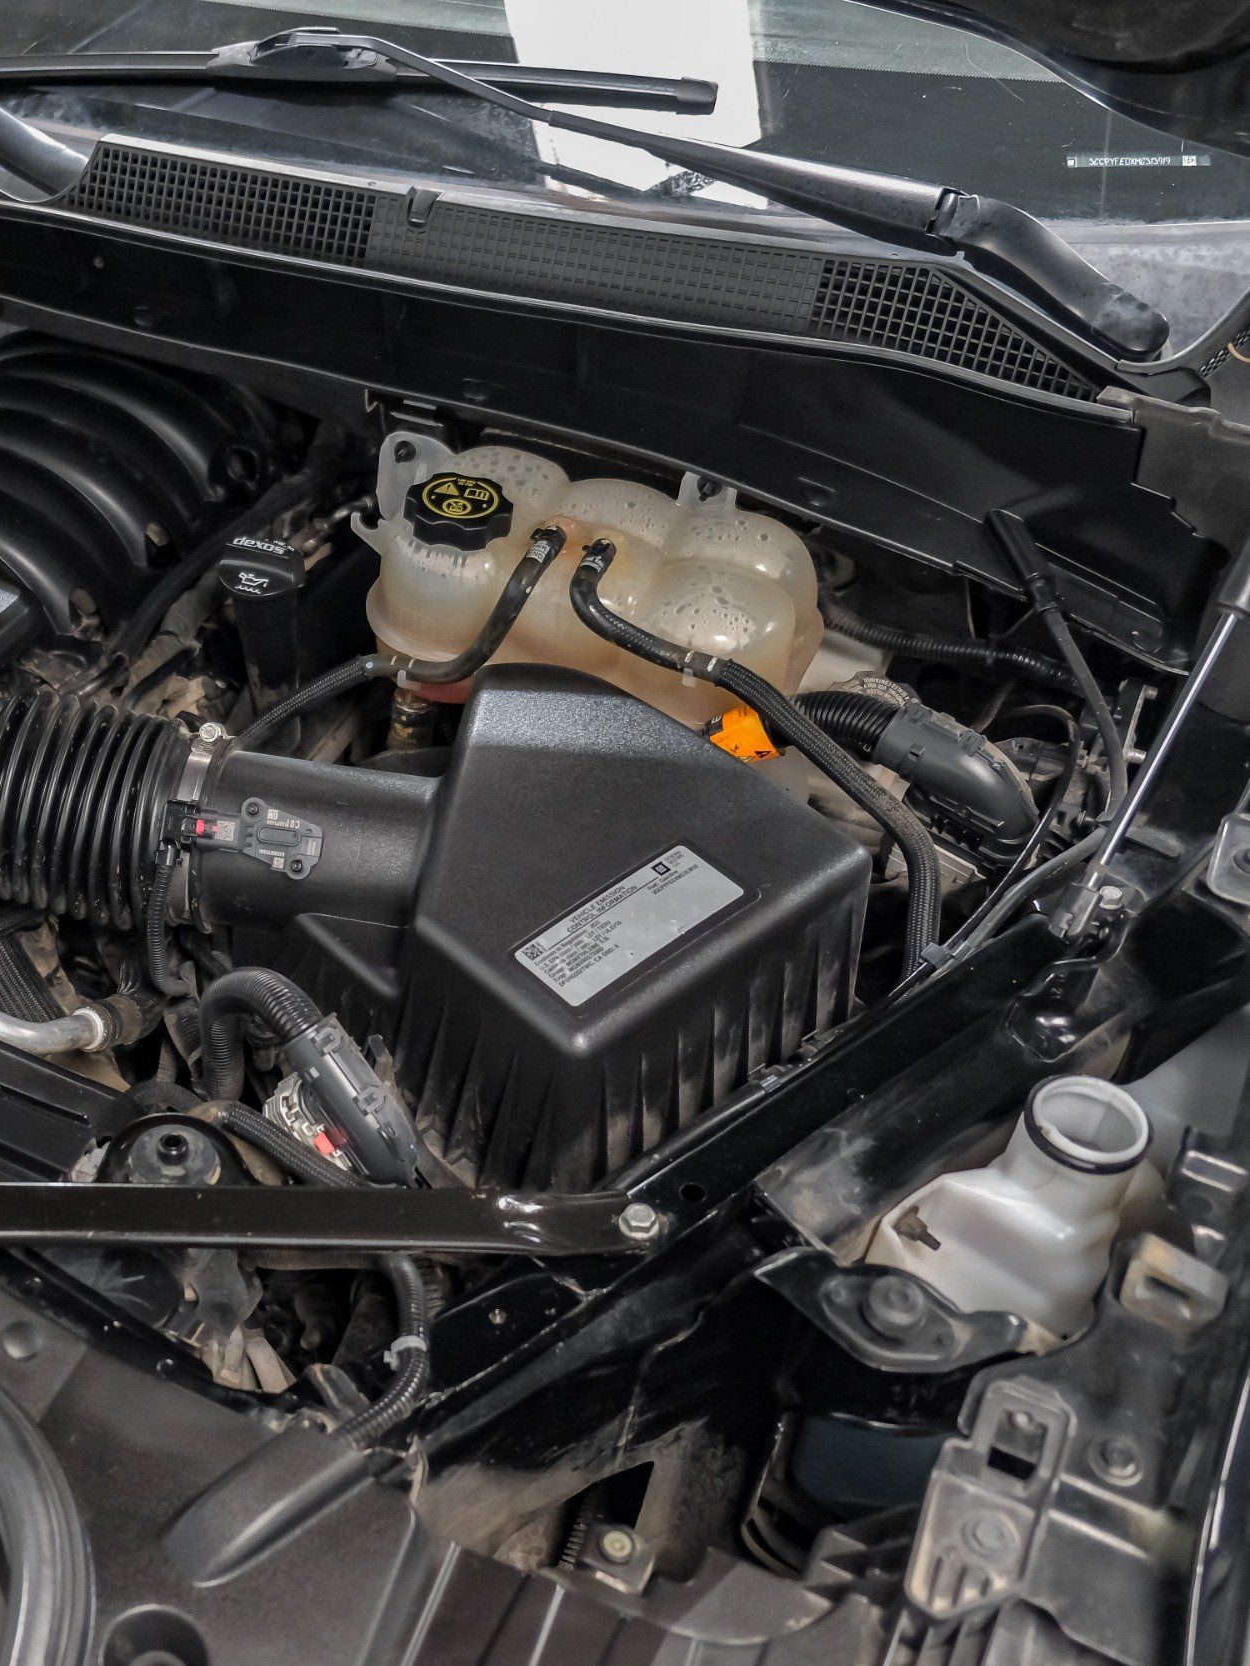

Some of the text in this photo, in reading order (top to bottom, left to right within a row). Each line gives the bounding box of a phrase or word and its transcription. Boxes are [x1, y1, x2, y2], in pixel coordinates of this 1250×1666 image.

[232, 536, 286, 555] dexos
[566, 885, 637, 932] CONTROL INFORMATION
[569, 885, 626, 922] VEHICLE EMISSION
